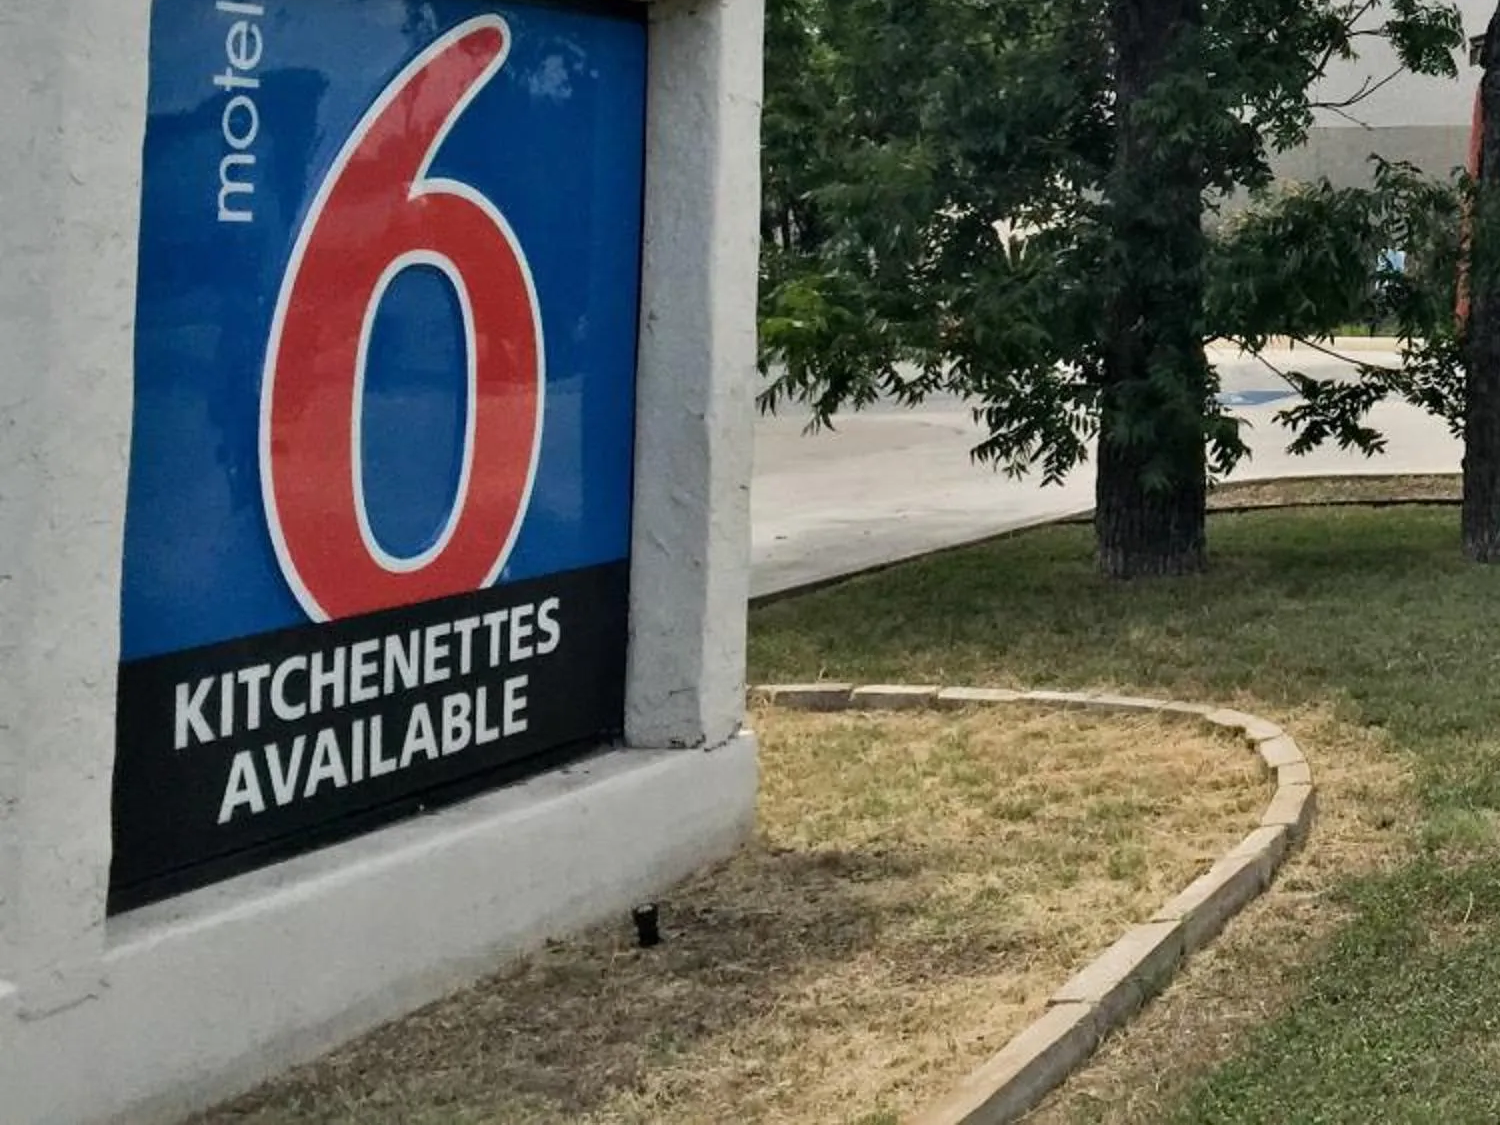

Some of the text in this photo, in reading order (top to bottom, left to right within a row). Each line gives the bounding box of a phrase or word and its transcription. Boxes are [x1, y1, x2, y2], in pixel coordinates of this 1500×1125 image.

[213, 0, 264, 223] motel
[258, 12, 546, 623] 6
[174, 596, 561, 750] KITCHENETTES
[217, 674, 529, 824] AVAILABLE
